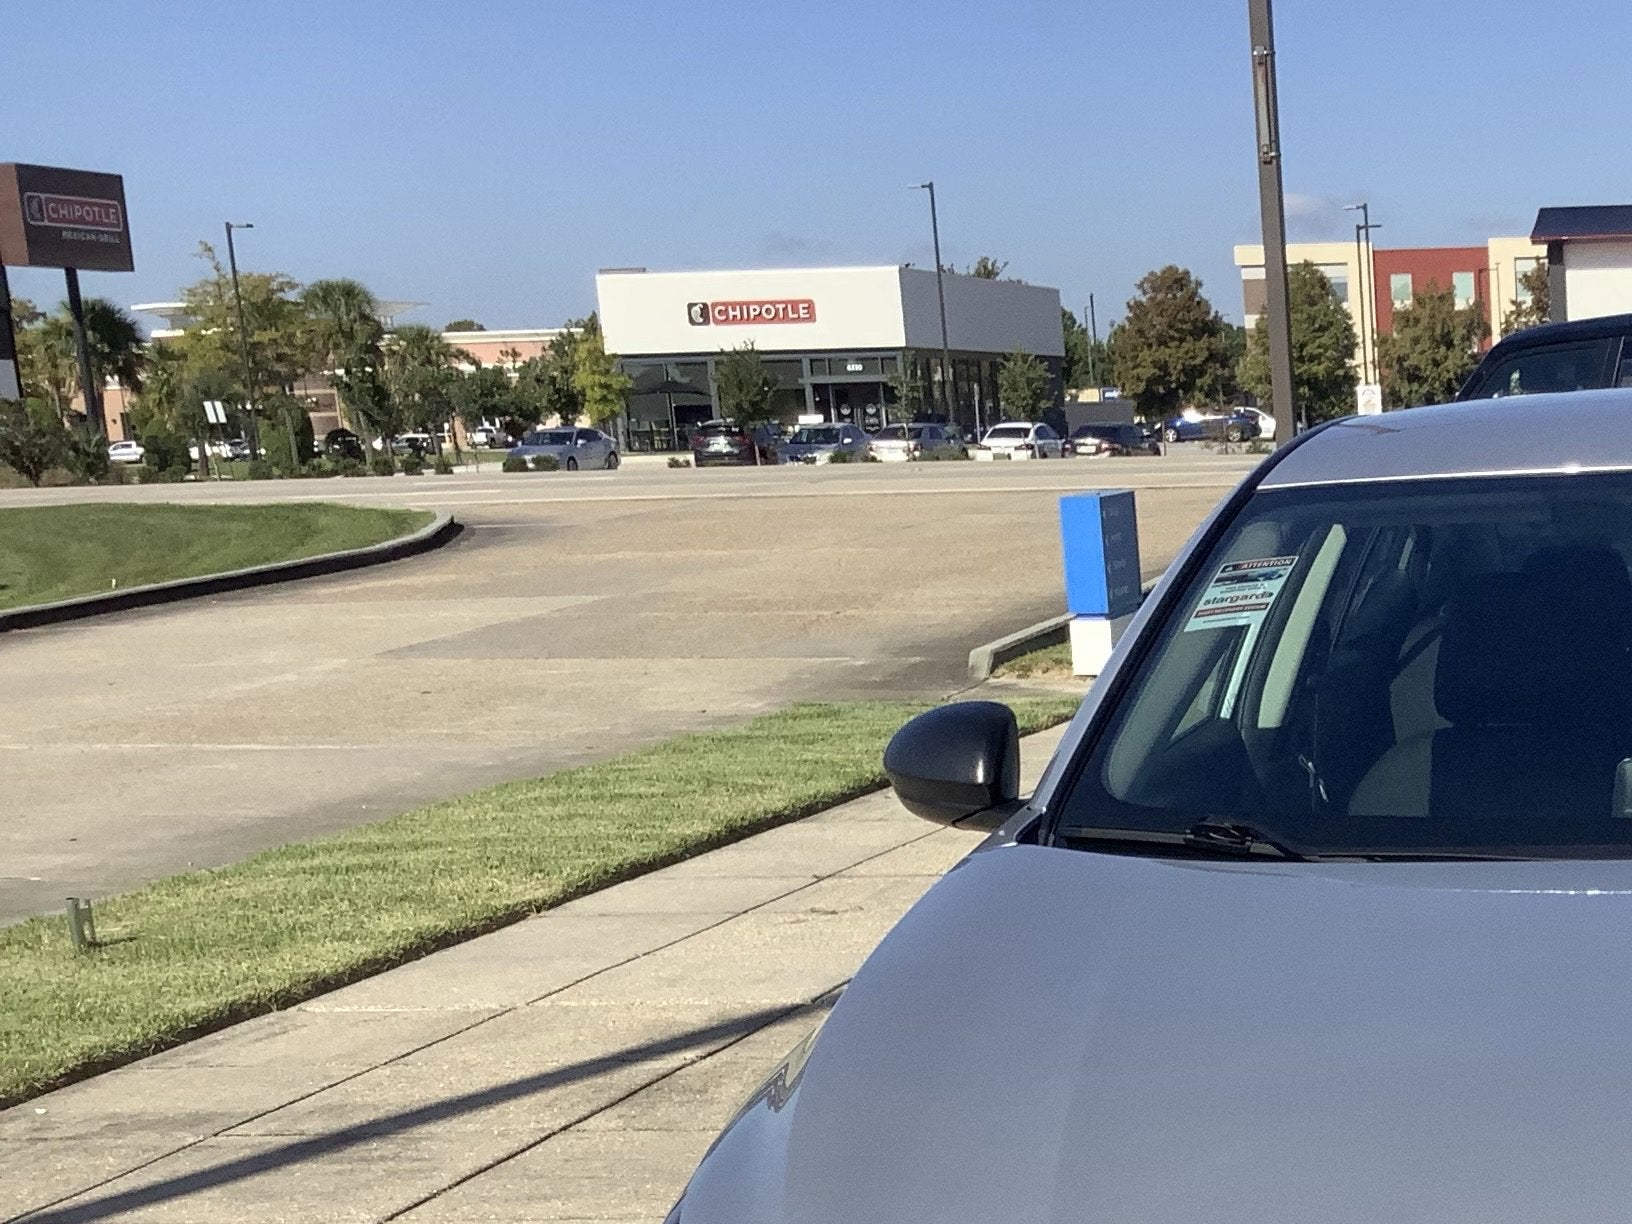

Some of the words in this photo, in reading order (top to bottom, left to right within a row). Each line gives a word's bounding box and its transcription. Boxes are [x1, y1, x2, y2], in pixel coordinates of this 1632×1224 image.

[47, 202, 119, 224] CHIPOTLE
[713, 303, 811, 321] CHIPOTLE
[1241, 559, 1292, 570] ATTENTION
